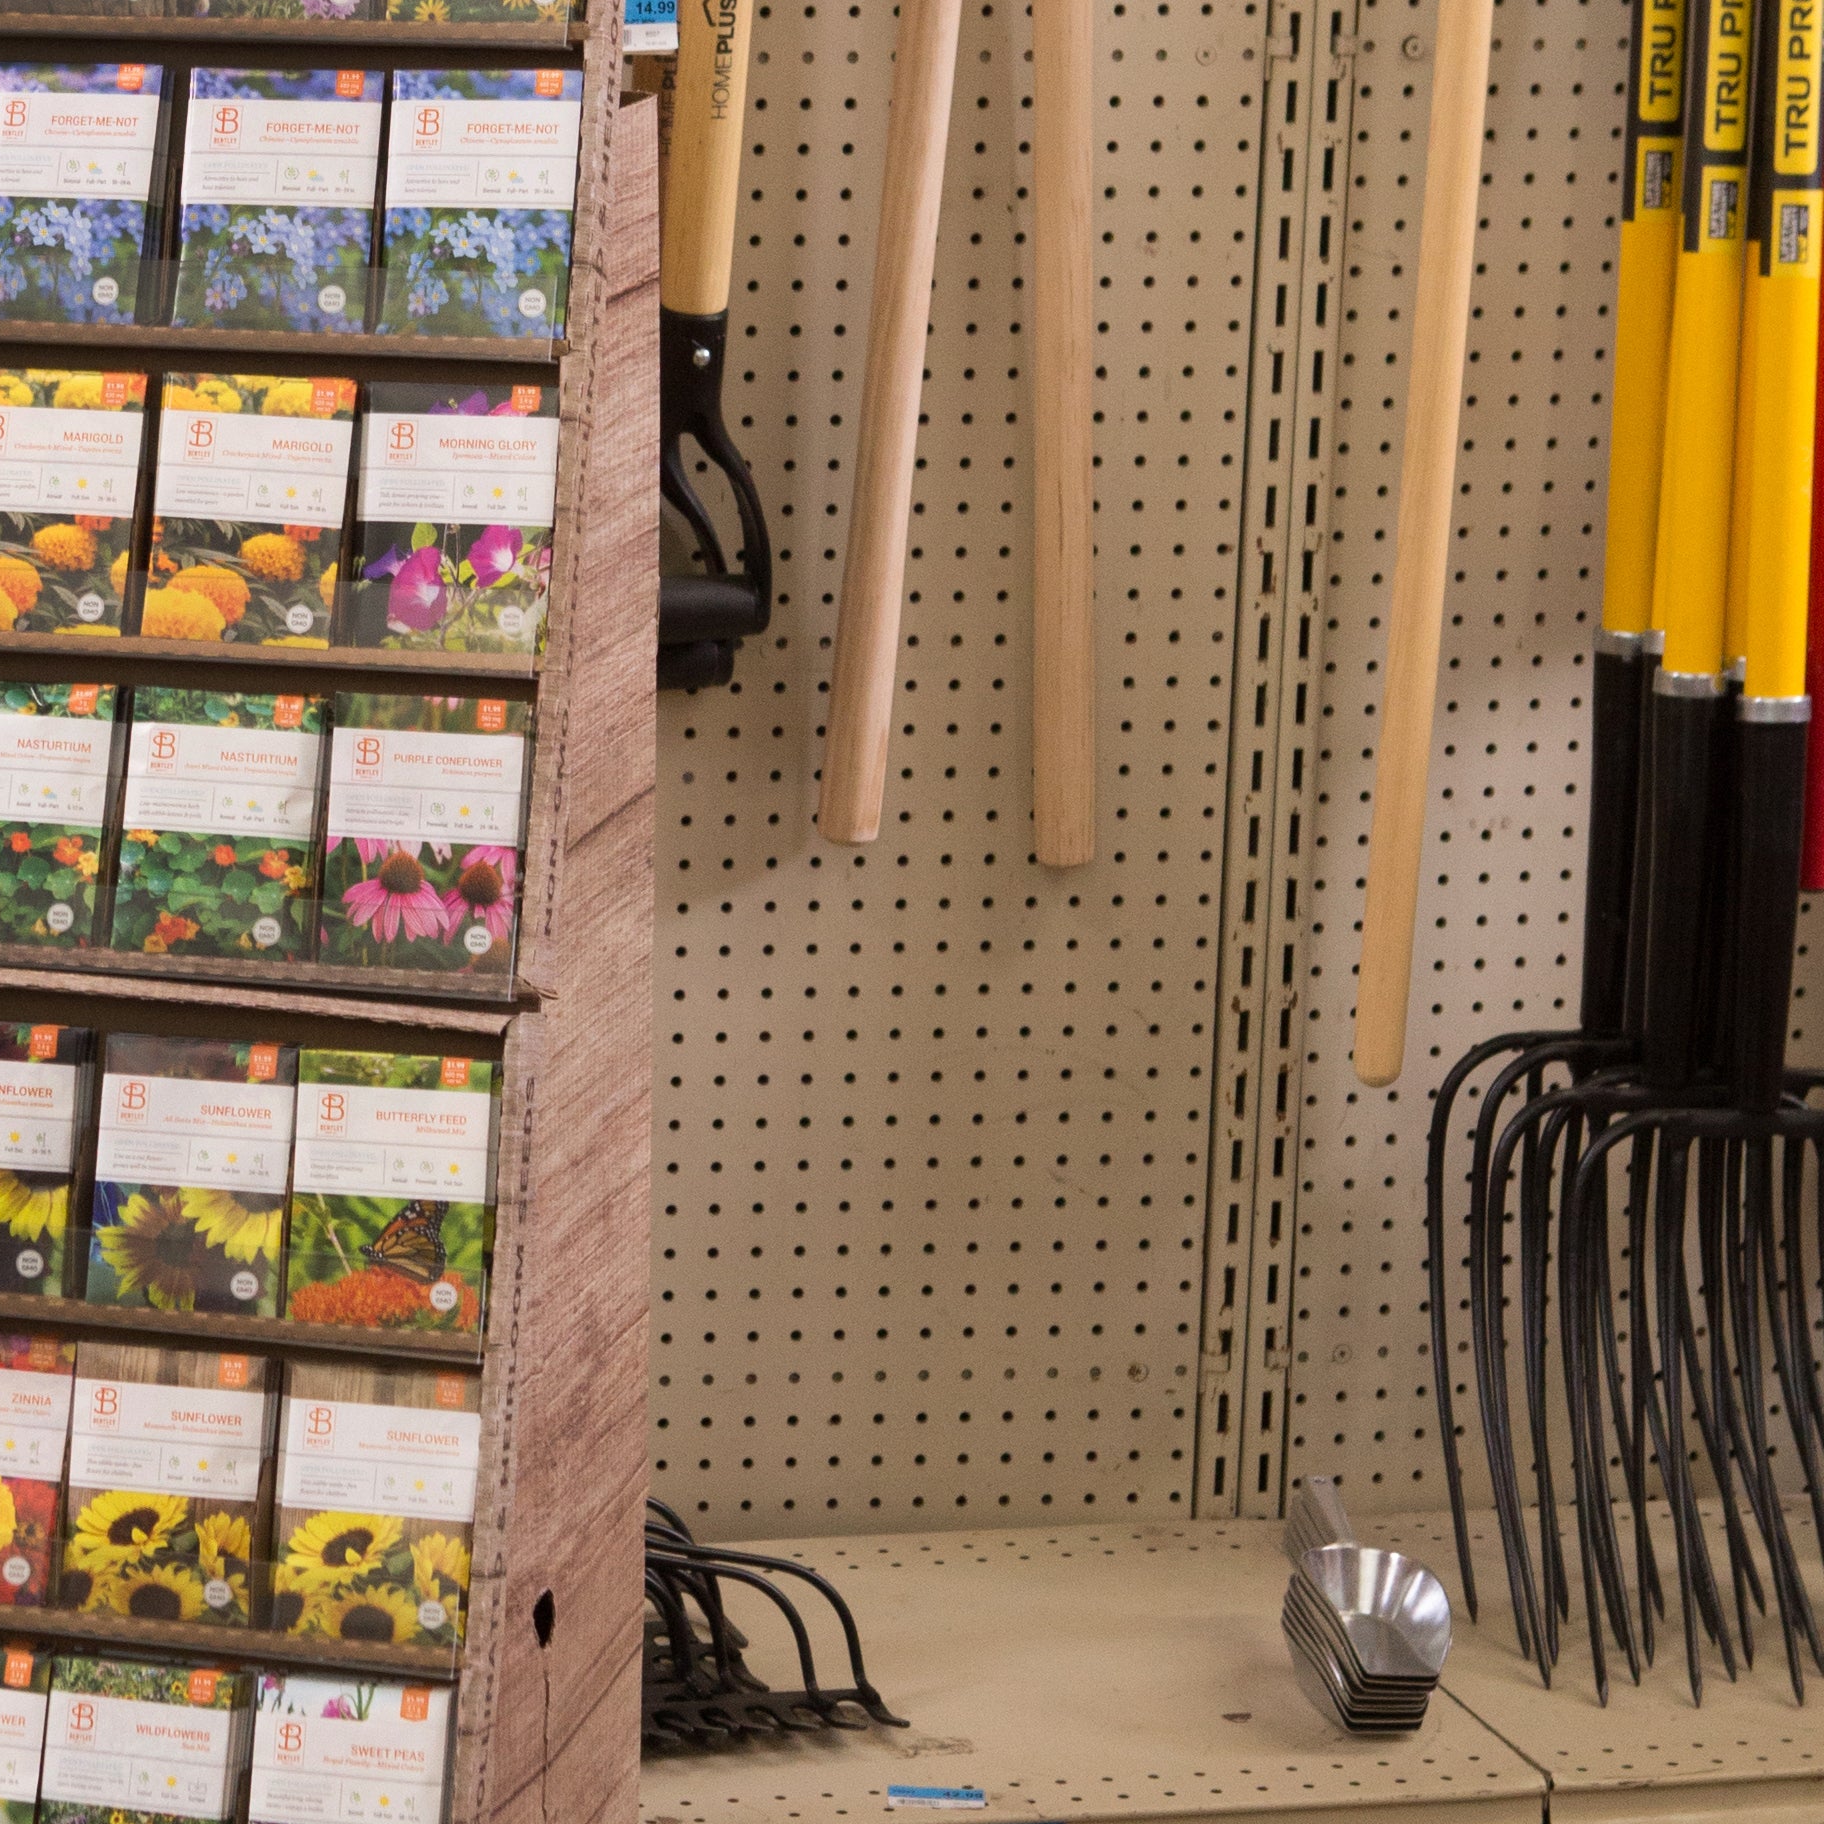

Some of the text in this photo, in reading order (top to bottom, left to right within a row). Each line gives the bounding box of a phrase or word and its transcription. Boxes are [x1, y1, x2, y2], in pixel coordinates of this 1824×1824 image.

[635, 1, 675, 15] 14.99
[1648, 25, 1676, 105] TRU
[1714, 51, 1741, 136] TRU
[51, 116, 138, 126] FORGET-ME-NOT
[1784, 76, 1811, 158] TRU
[266, 122, 359, 134] FORGET-ME-NOT
[466, 123, 559, 134] FORGET-ME-NOT
[63, 432, 124, 444] MARIGOLD
[439, 439, 536, 450] MORNING GLORY
[272, 440, 333, 453] MARIGOLD
[17, 739, 92, 753] NASTURTIUM
[220, 752, 298, 766] NASTURTIUM
[393, 753, 503, 768] PURPLE CONEFLOWER
[201, 1105, 272, 1119] SUNFLOWER
[375, 1111, 467, 1126] BUTTERFLY FEED
[517, 1074, 536, 1225] SEEDS
[12, 1392, 52, 1406] ZINNIA
[171, 1411, 243, 1426] SUNFLOWER
[387, 1430, 459, 1447] SUNFLOWER
